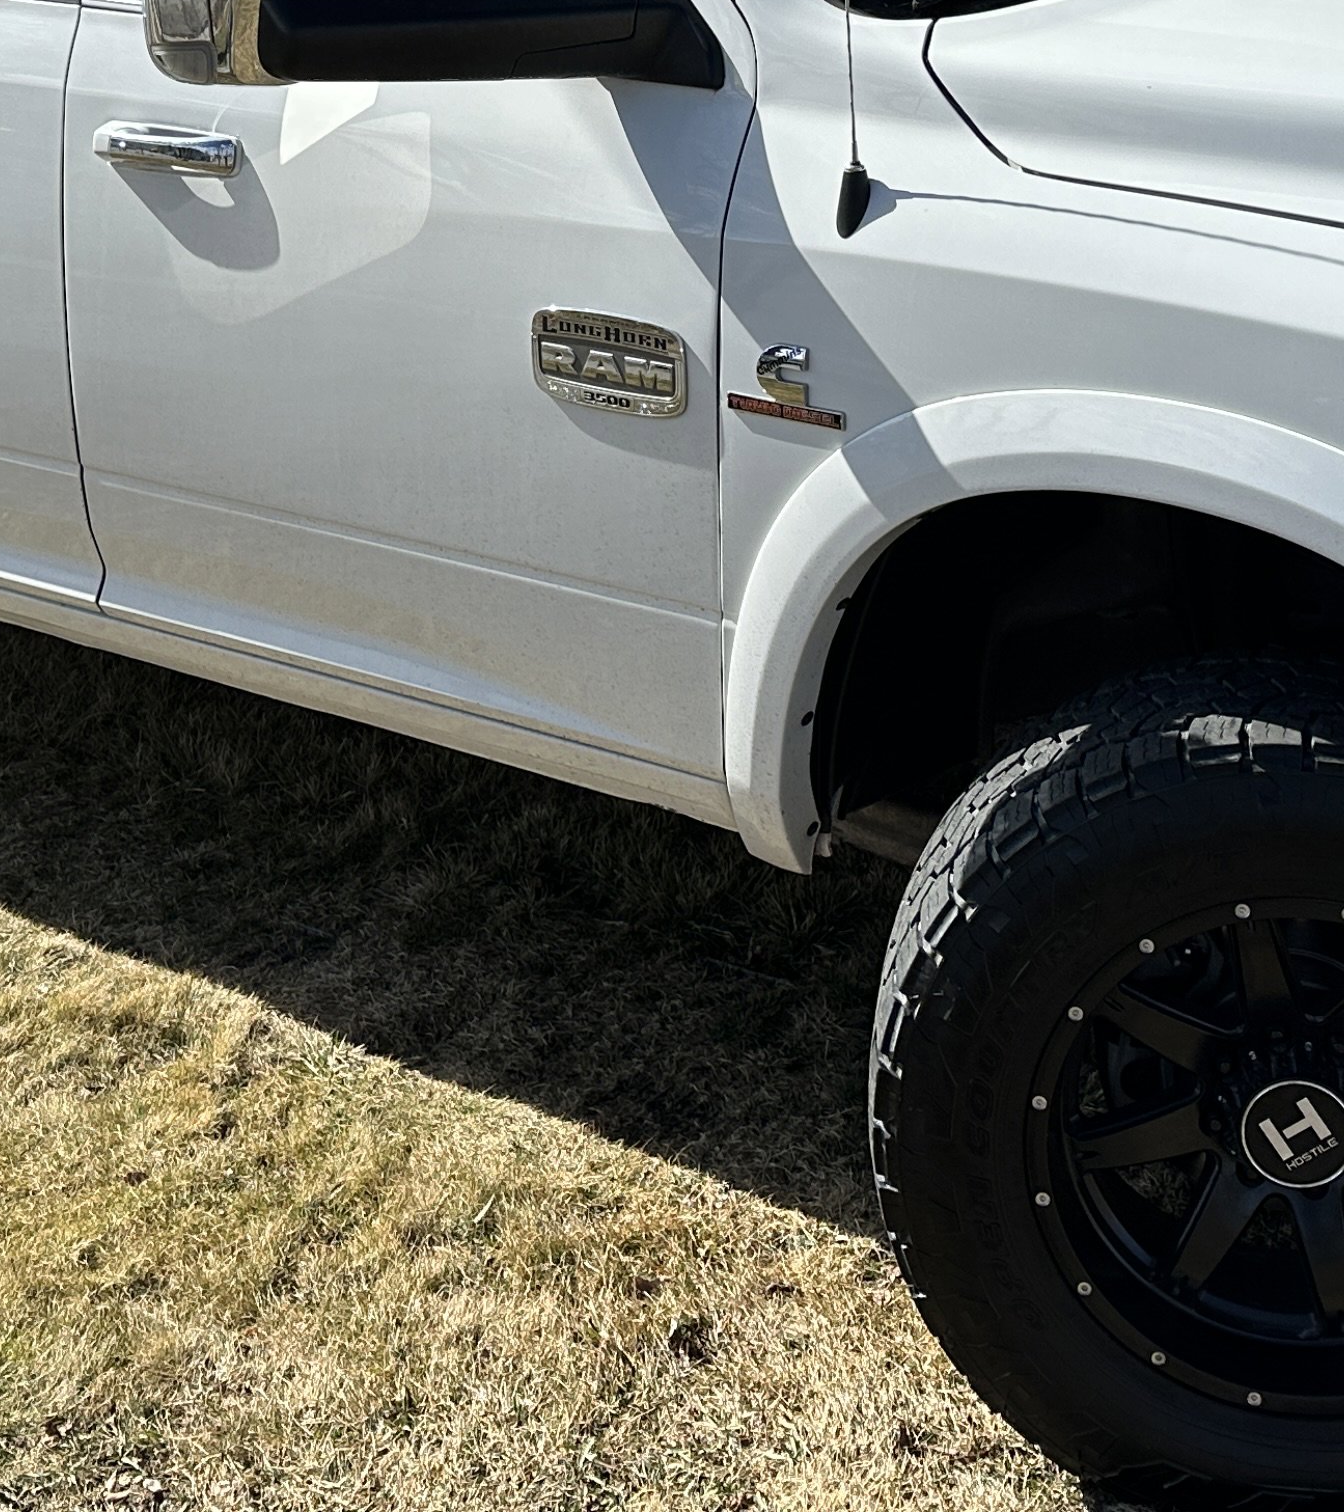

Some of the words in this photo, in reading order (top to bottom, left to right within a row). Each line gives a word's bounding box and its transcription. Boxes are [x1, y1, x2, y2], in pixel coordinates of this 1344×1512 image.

[540, 341, 674, 393] RAM
[583, 390, 631, 408] 3500
[1285, 1136, 1339, 1171] HOSTILE
